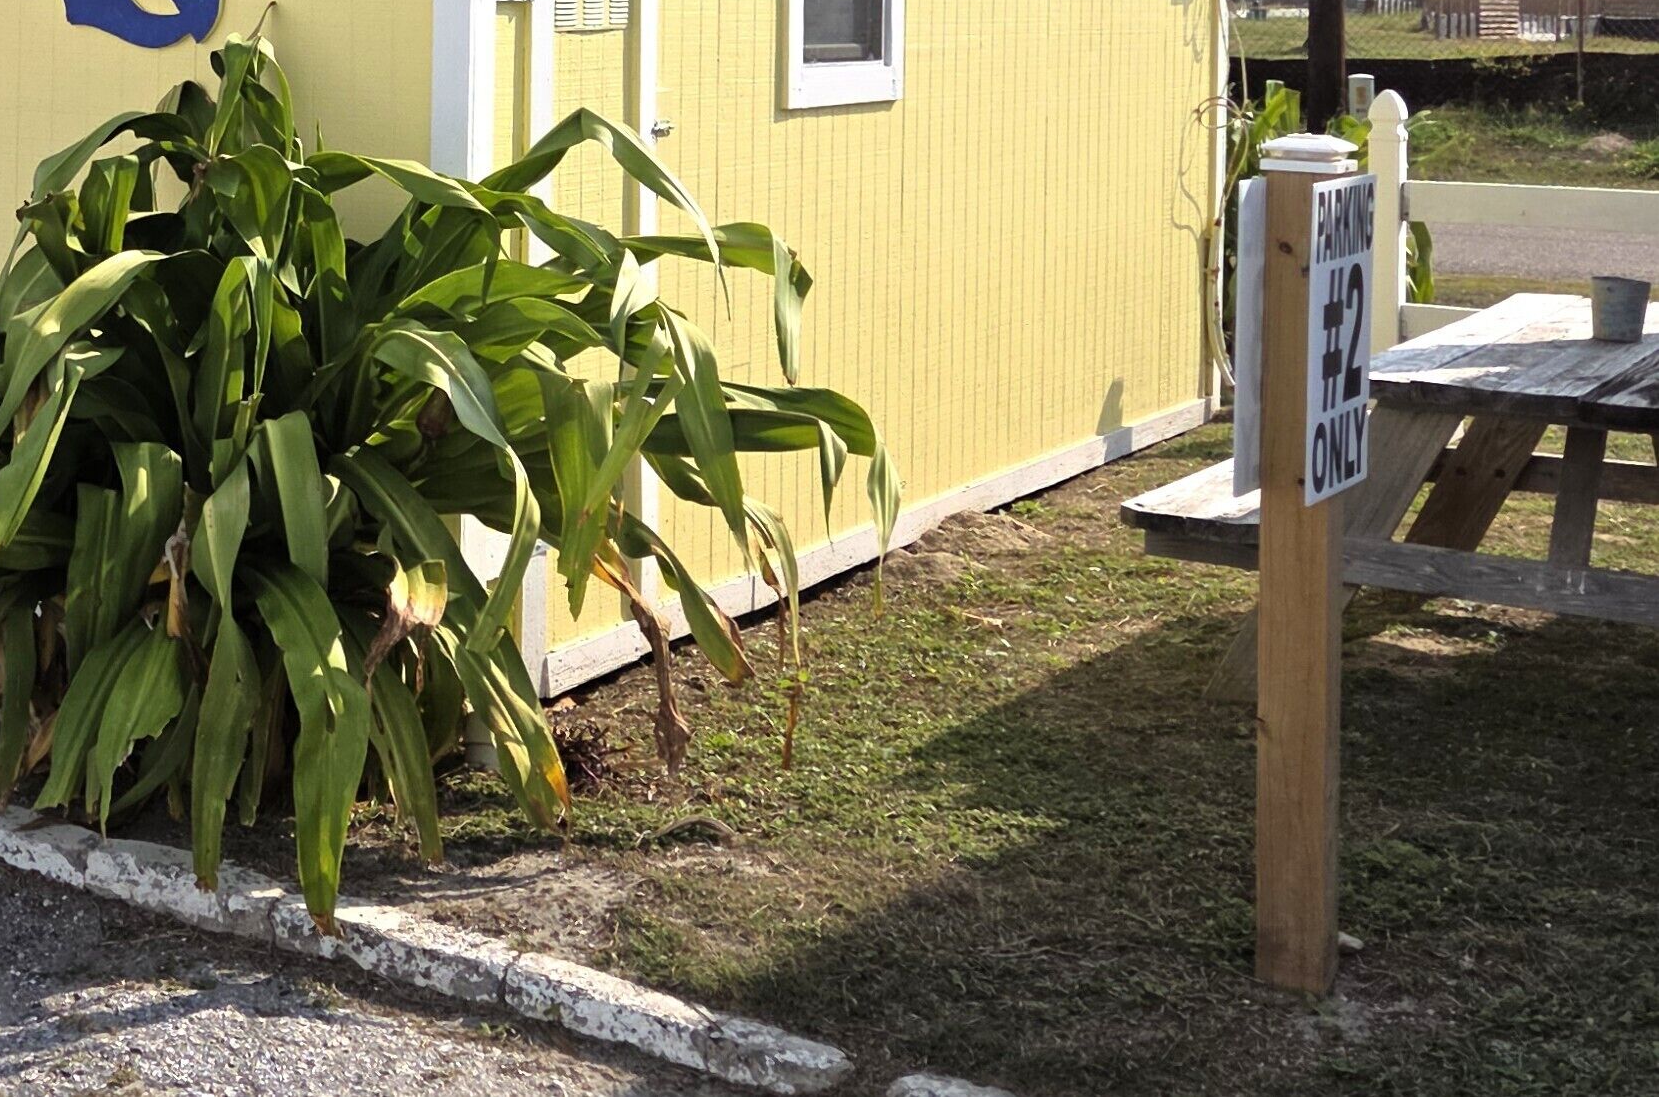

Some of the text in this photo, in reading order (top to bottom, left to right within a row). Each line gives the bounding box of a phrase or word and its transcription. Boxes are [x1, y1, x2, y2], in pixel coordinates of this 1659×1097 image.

[1315, 182, 1374, 264] PARKING
[1322, 263, 1364, 413] #2
[1311, 403, 1367, 494] ONLY
